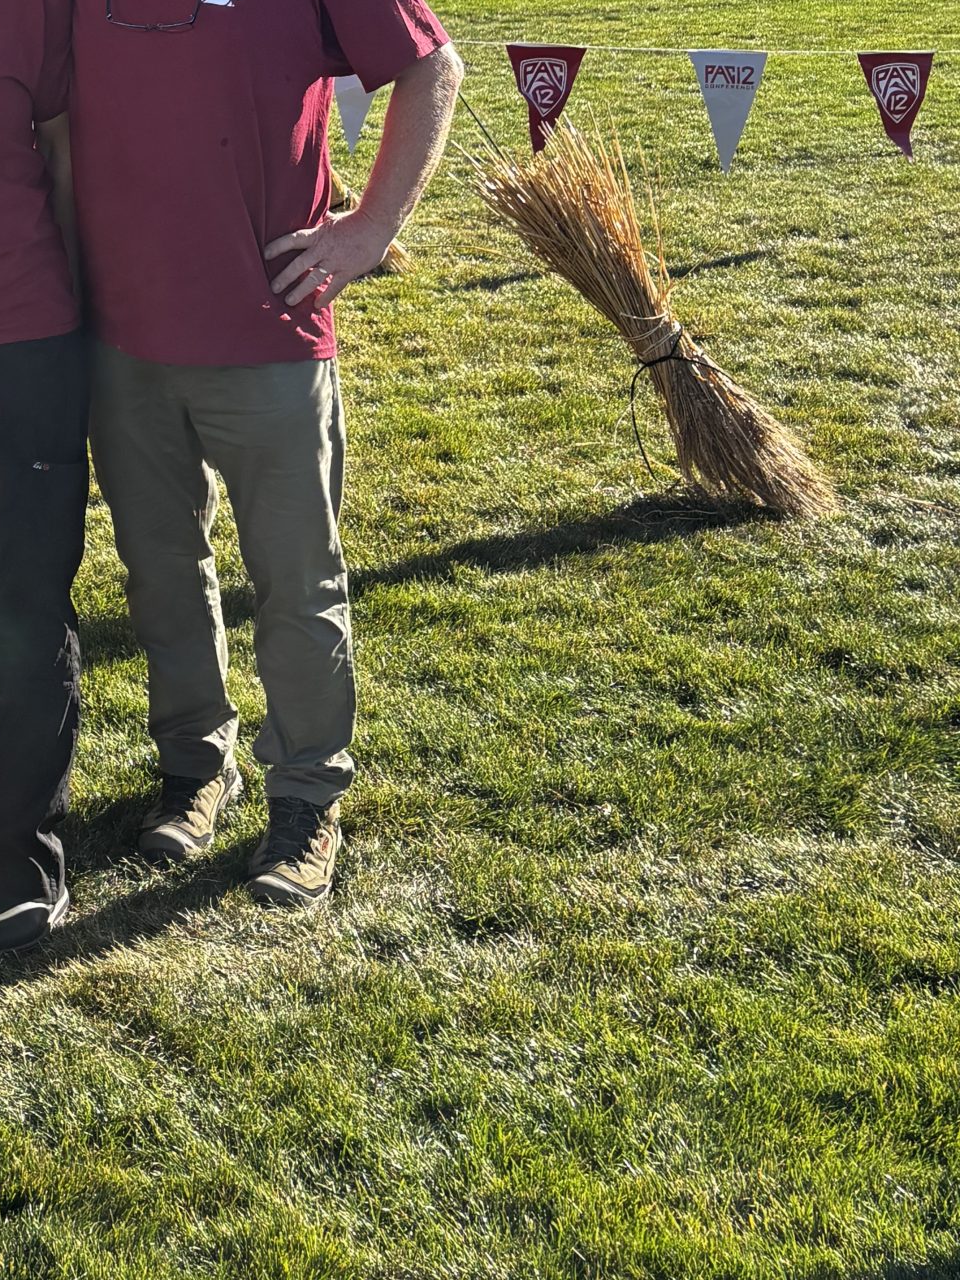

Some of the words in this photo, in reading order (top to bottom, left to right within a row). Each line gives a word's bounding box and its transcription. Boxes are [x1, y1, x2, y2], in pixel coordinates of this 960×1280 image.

[523, 60, 565, 95] PAC
[875, 66, 917, 100] PAC
[535, 88, 554, 105] 12
[890, 93, 909, 111] 12
